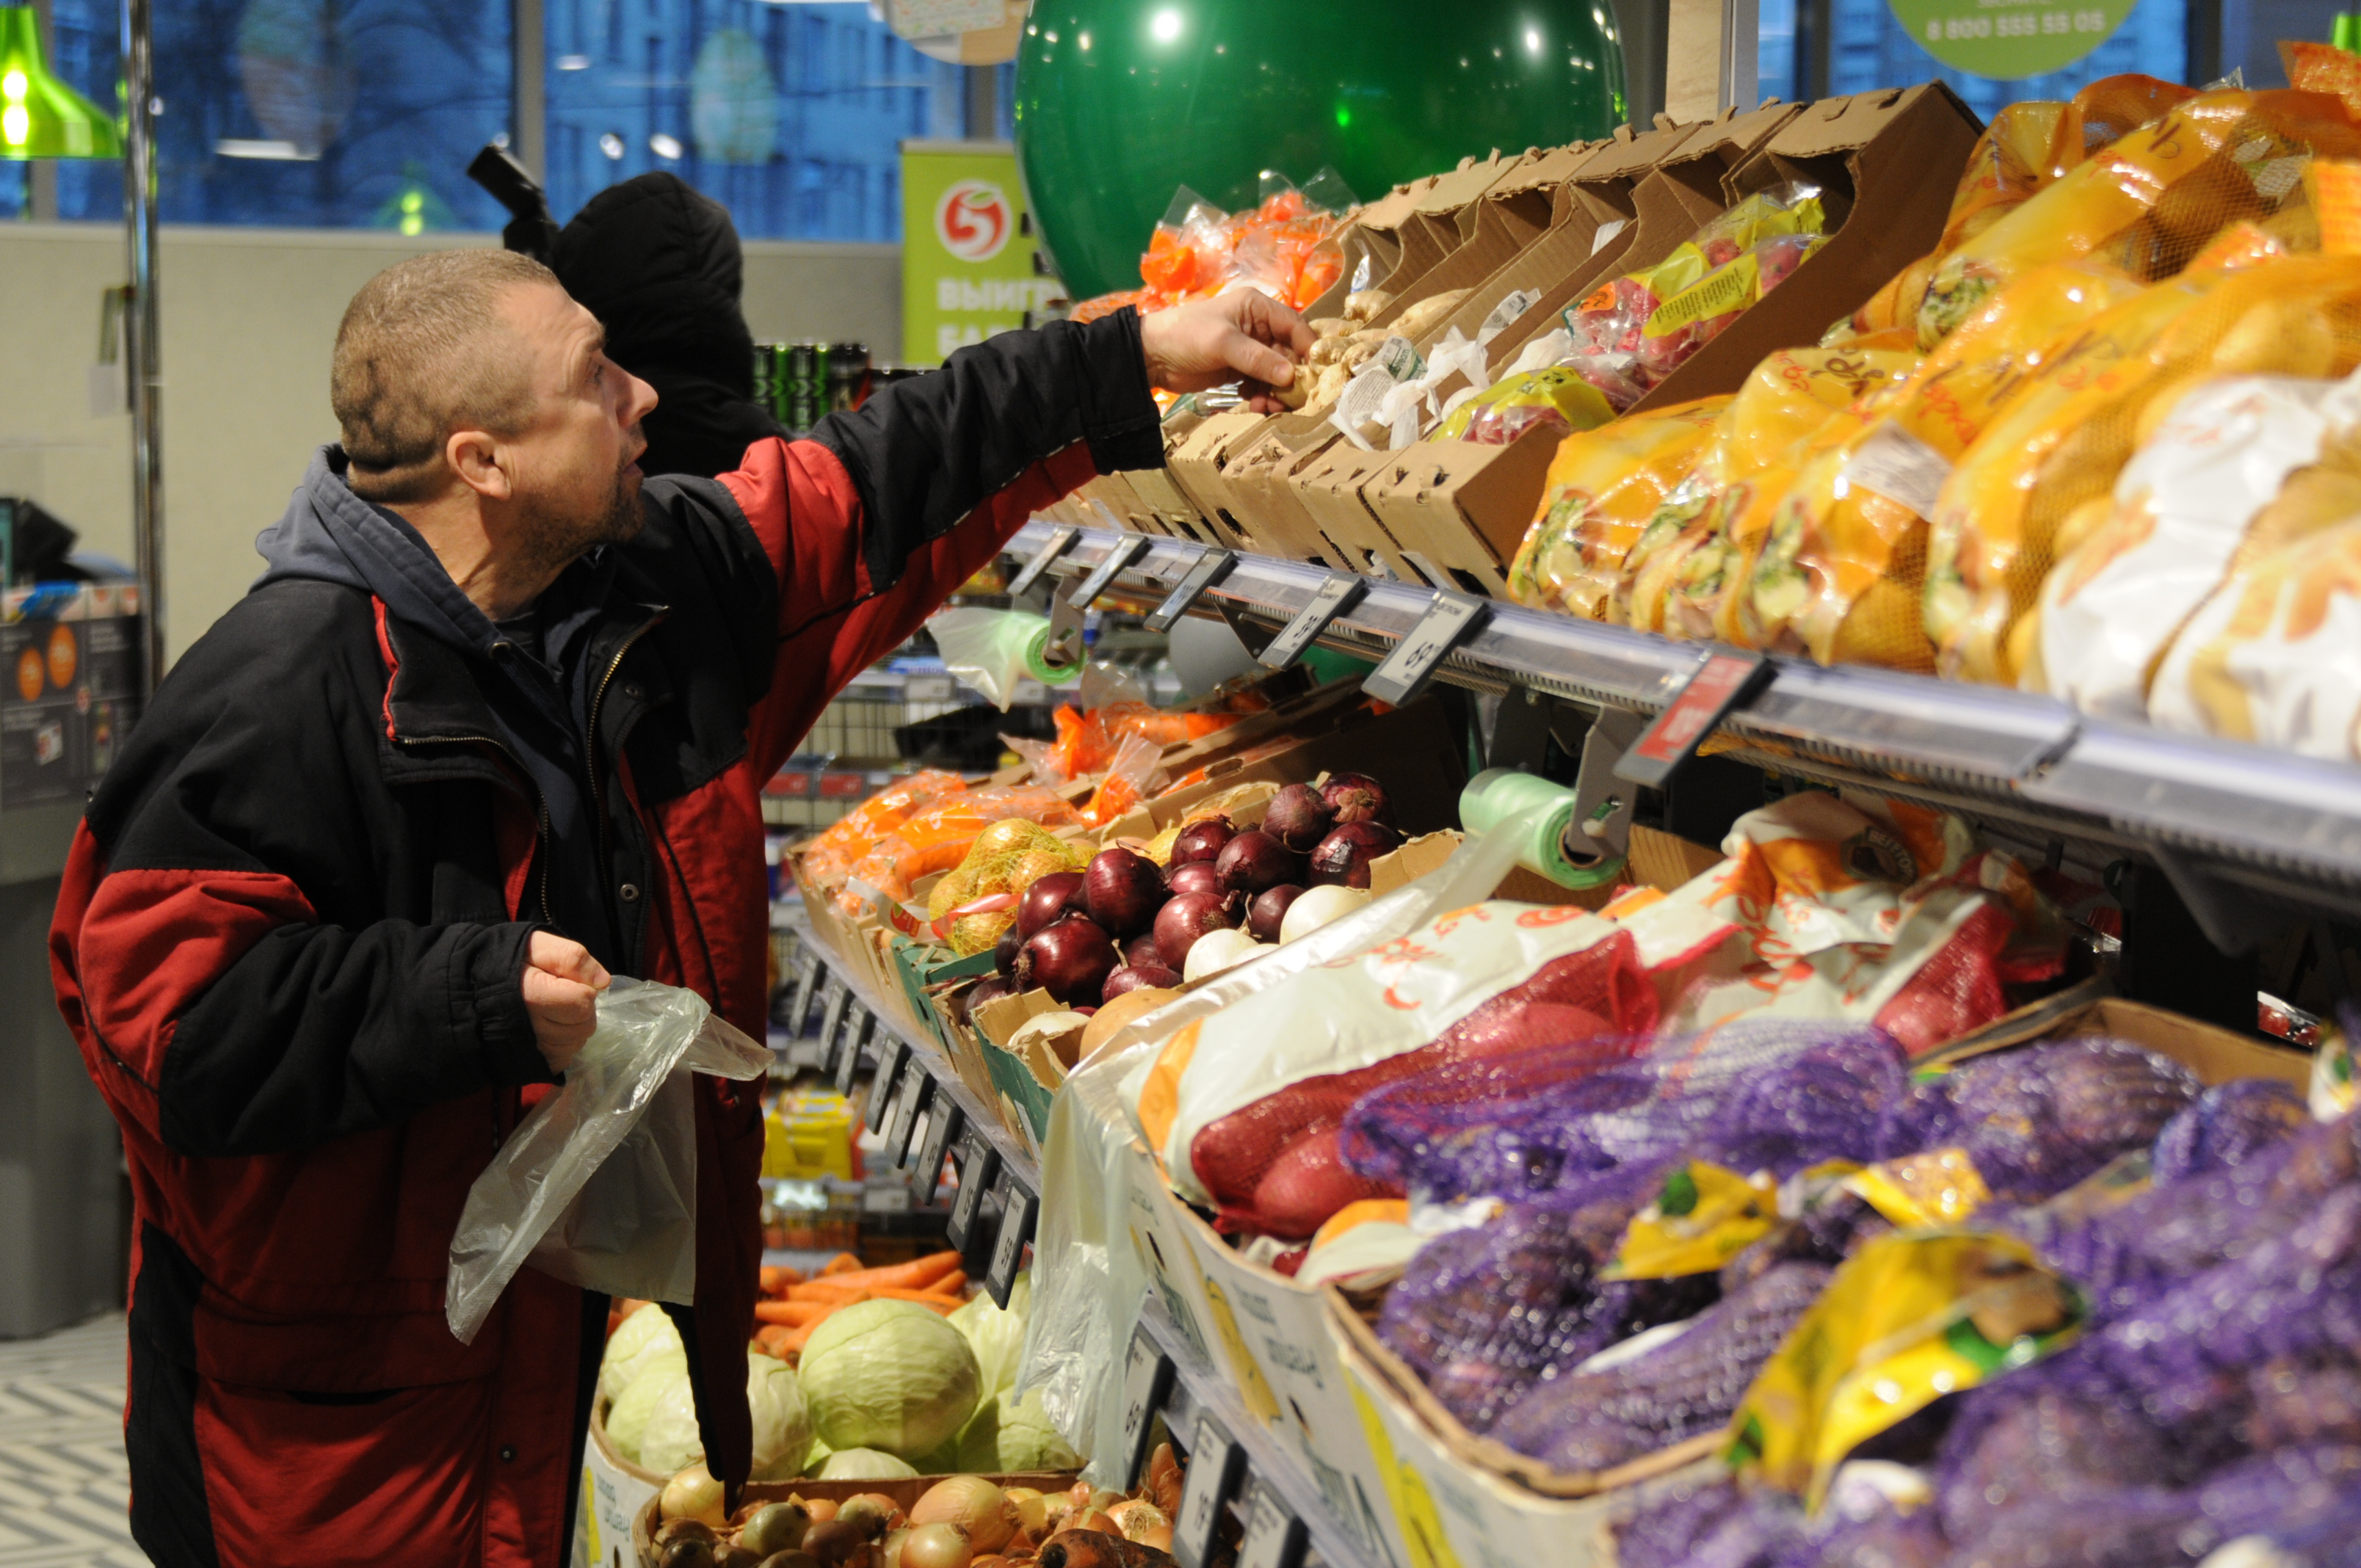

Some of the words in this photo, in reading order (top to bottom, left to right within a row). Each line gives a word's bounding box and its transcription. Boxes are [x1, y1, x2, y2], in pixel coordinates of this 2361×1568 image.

[1926, 18, 1943, 41] 8
[1945, 15, 1992, 39] 800
[1995, 12, 2039, 37] 555
[2042, 10, 2071, 34] 55
[2074, 9, 2106, 32] 05
[937, 279, 1068, 312] ВЫИГР
[1293, 615, 1319, 639] 39
[1405, 641, 1434, 669] 69
